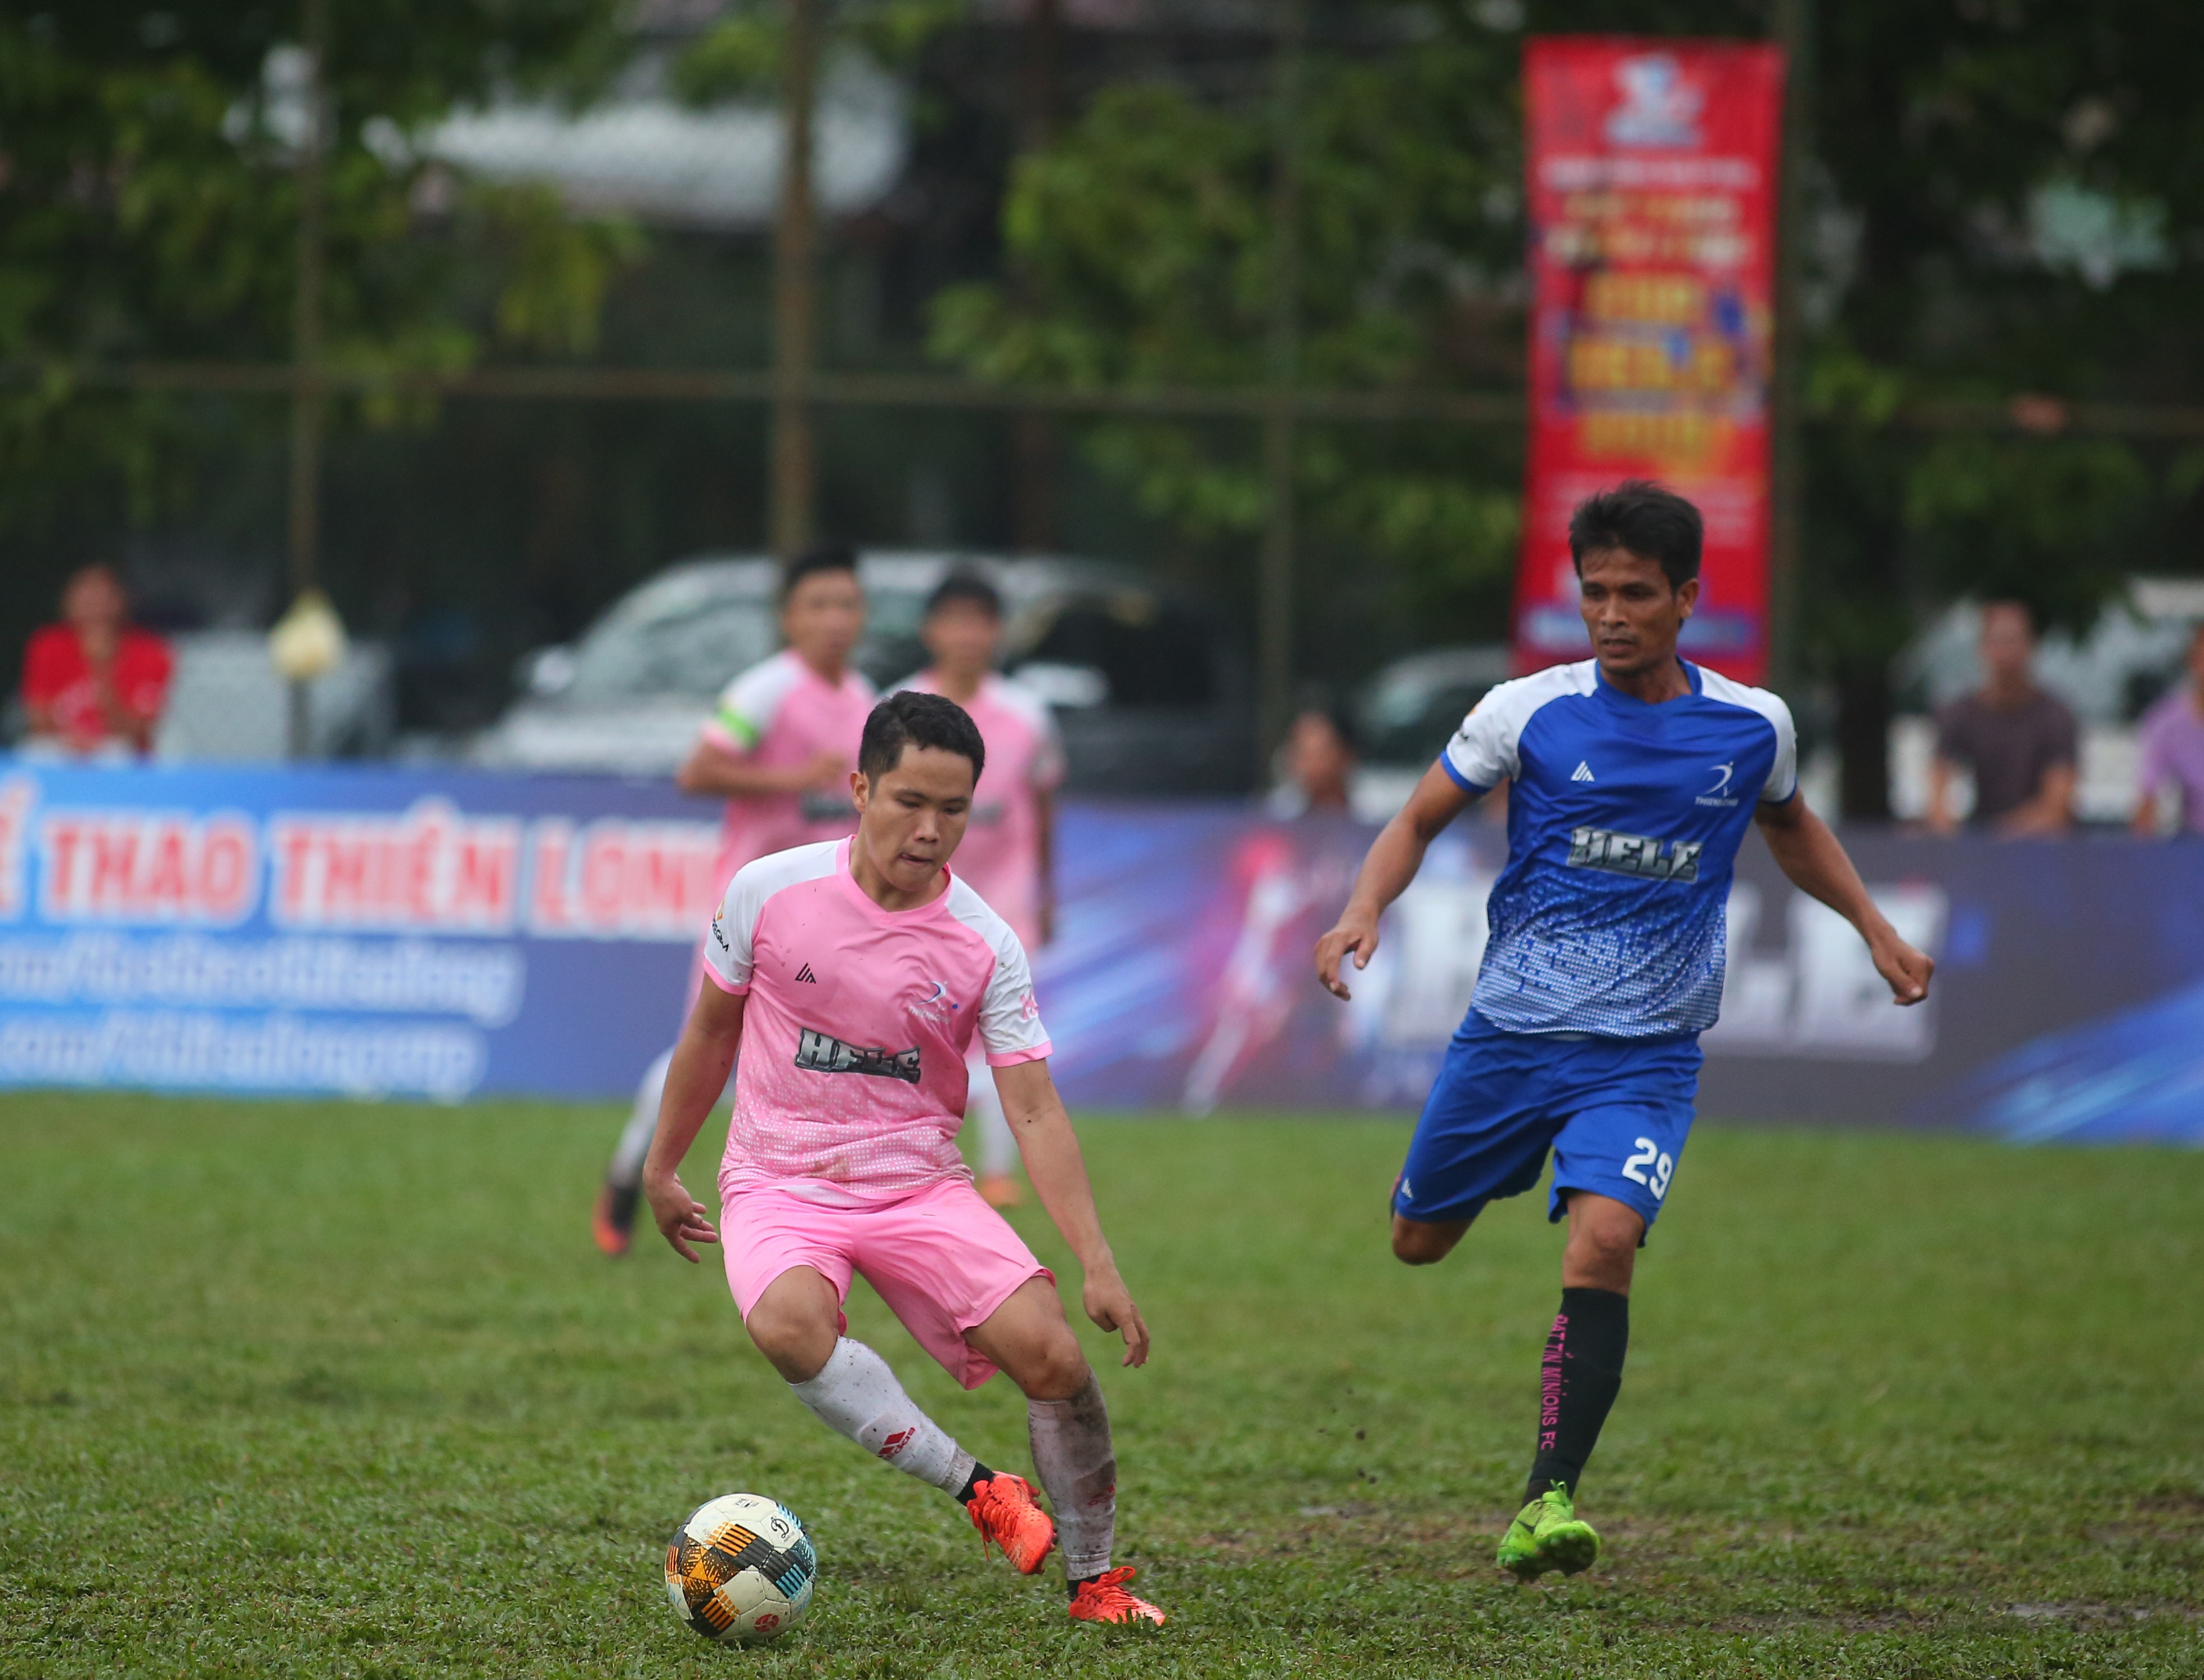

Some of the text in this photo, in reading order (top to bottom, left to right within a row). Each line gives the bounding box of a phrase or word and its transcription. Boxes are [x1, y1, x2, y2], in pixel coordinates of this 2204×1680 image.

[48, 815, 255, 921] THAO
[1567, 825, 1703, 885] HELE
[794, 1027, 921, 1085] HELE
[1622, 1137, 1673, 1201] 29
[1540, 1431, 1556, 1450] FC
